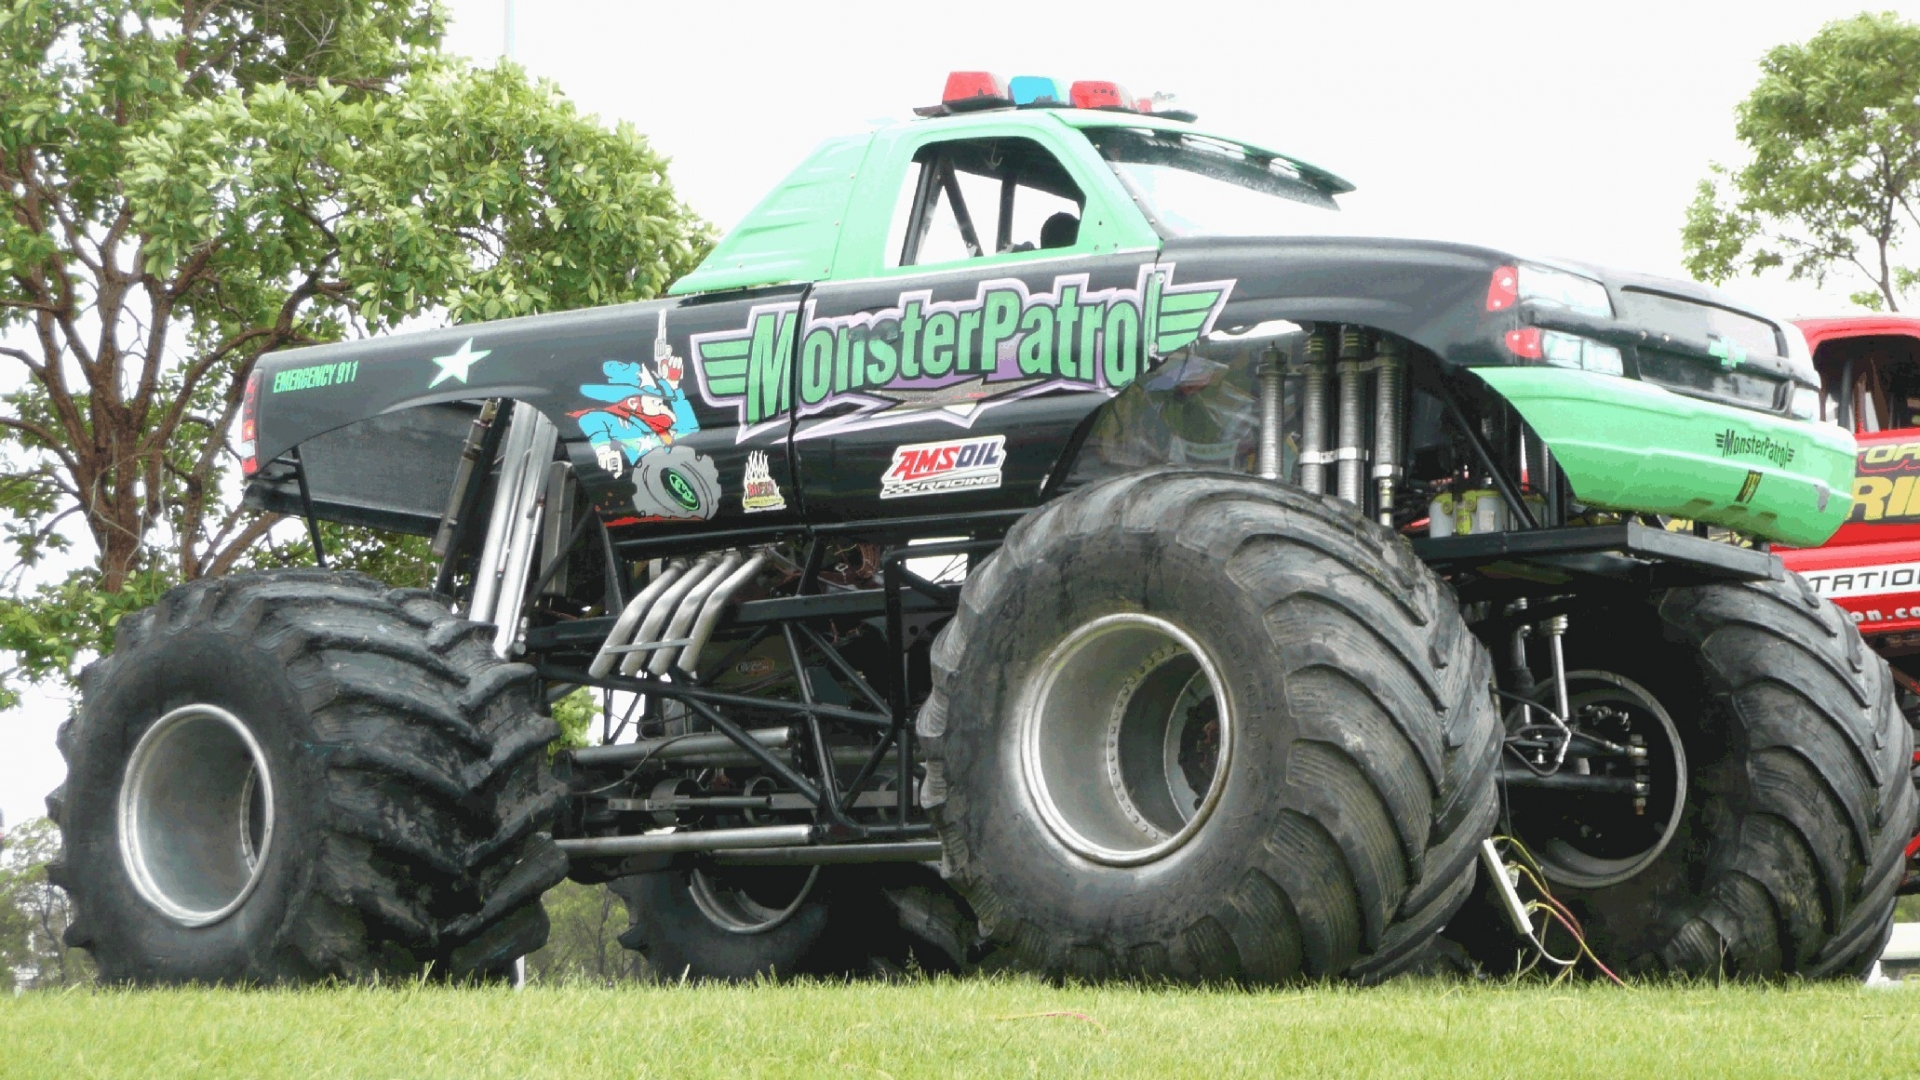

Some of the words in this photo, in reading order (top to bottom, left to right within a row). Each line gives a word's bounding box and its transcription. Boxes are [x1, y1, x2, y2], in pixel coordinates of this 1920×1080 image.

[747, 271, 1163, 424] MonsterPatrol
[273, 363, 337, 393] EMERGENCY
[336, 361, 359, 384] 911
[891, 441, 1000, 481] AMSOIL
[1722, 428, 1789, 470] MonsterPatrol
[919, 475, 999, 492] RACING
[1808, 569, 1920, 593] TATIO
